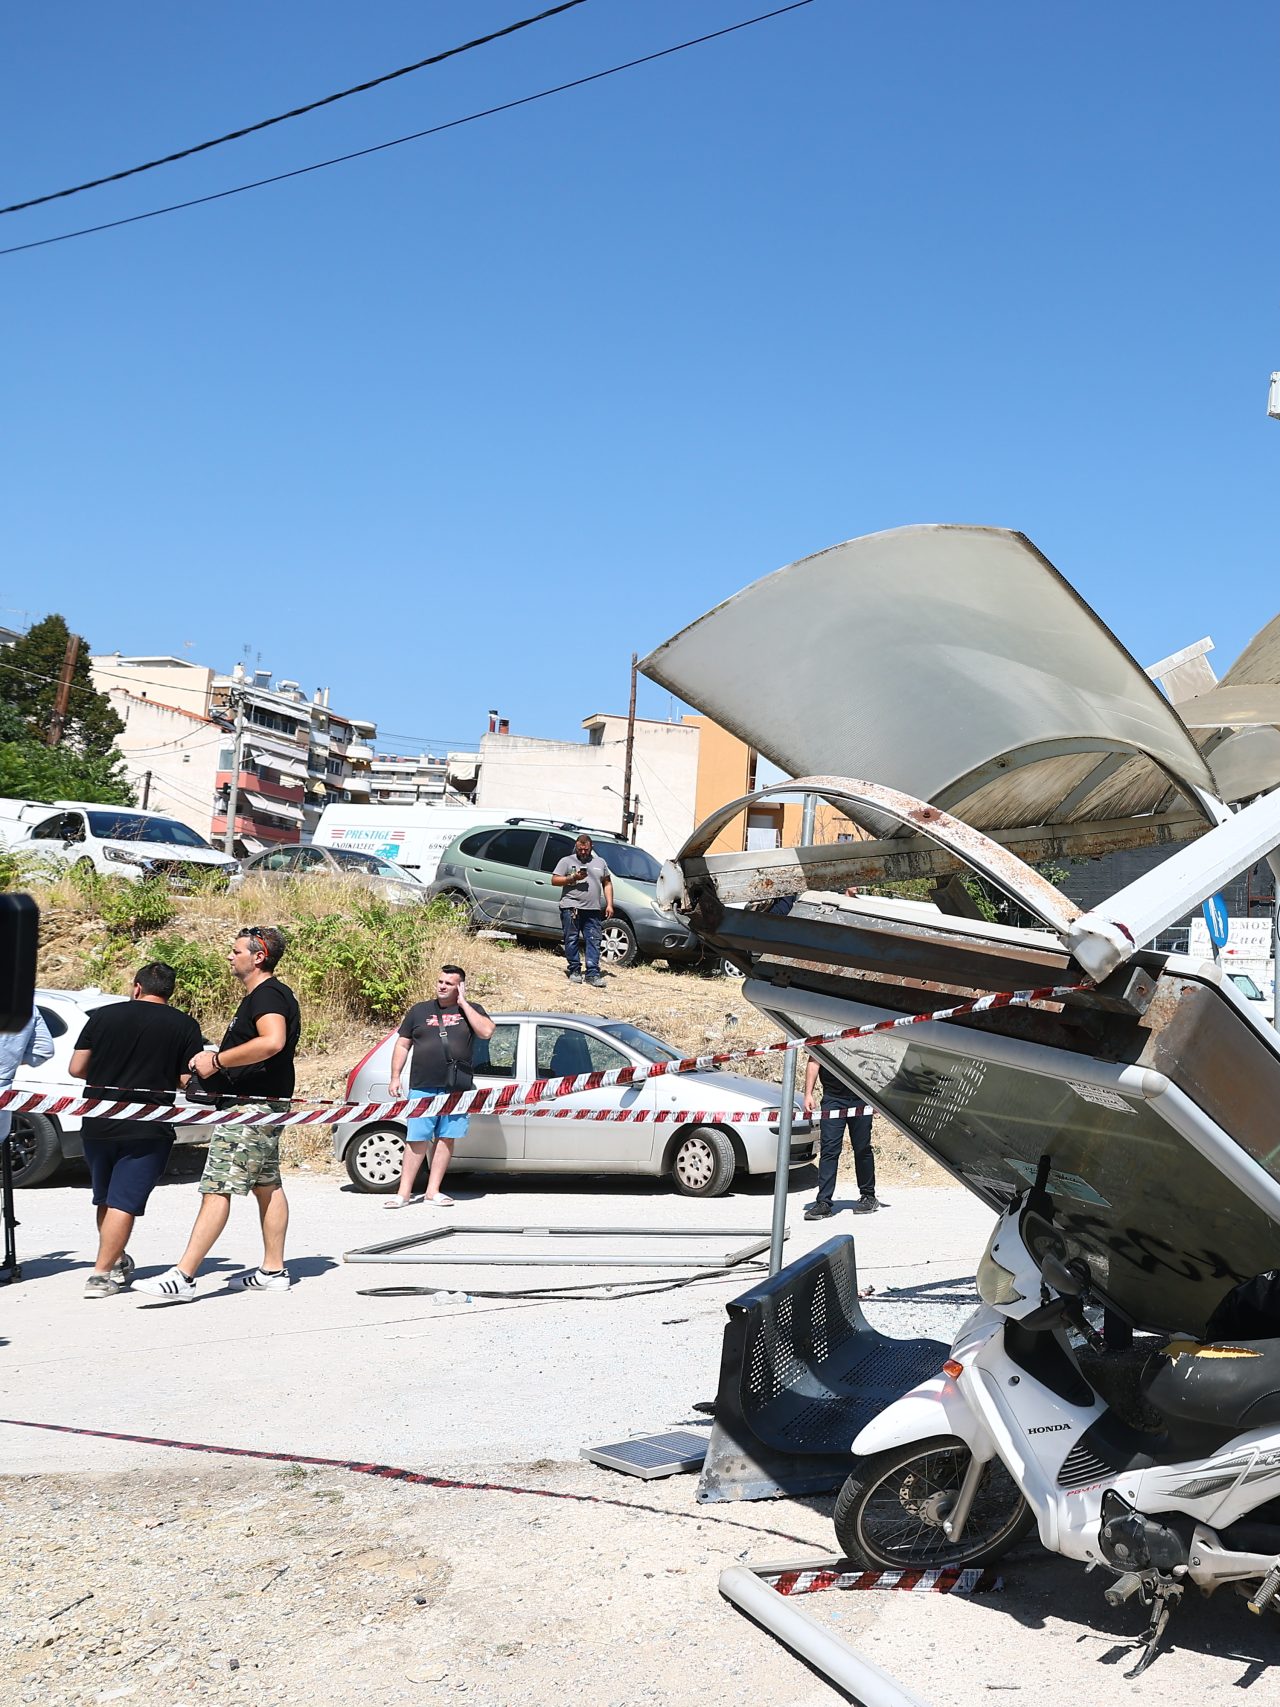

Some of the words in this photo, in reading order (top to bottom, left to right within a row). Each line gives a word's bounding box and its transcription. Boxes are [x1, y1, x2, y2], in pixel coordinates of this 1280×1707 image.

[344, 829, 391, 840] PRESTIGE
[1194, 921, 1270, 930] ΦΣΜΟΣ
[1028, 1423, 1072, 1435] HONDA
[1066, 1484, 1102, 1497] PGM-FI
